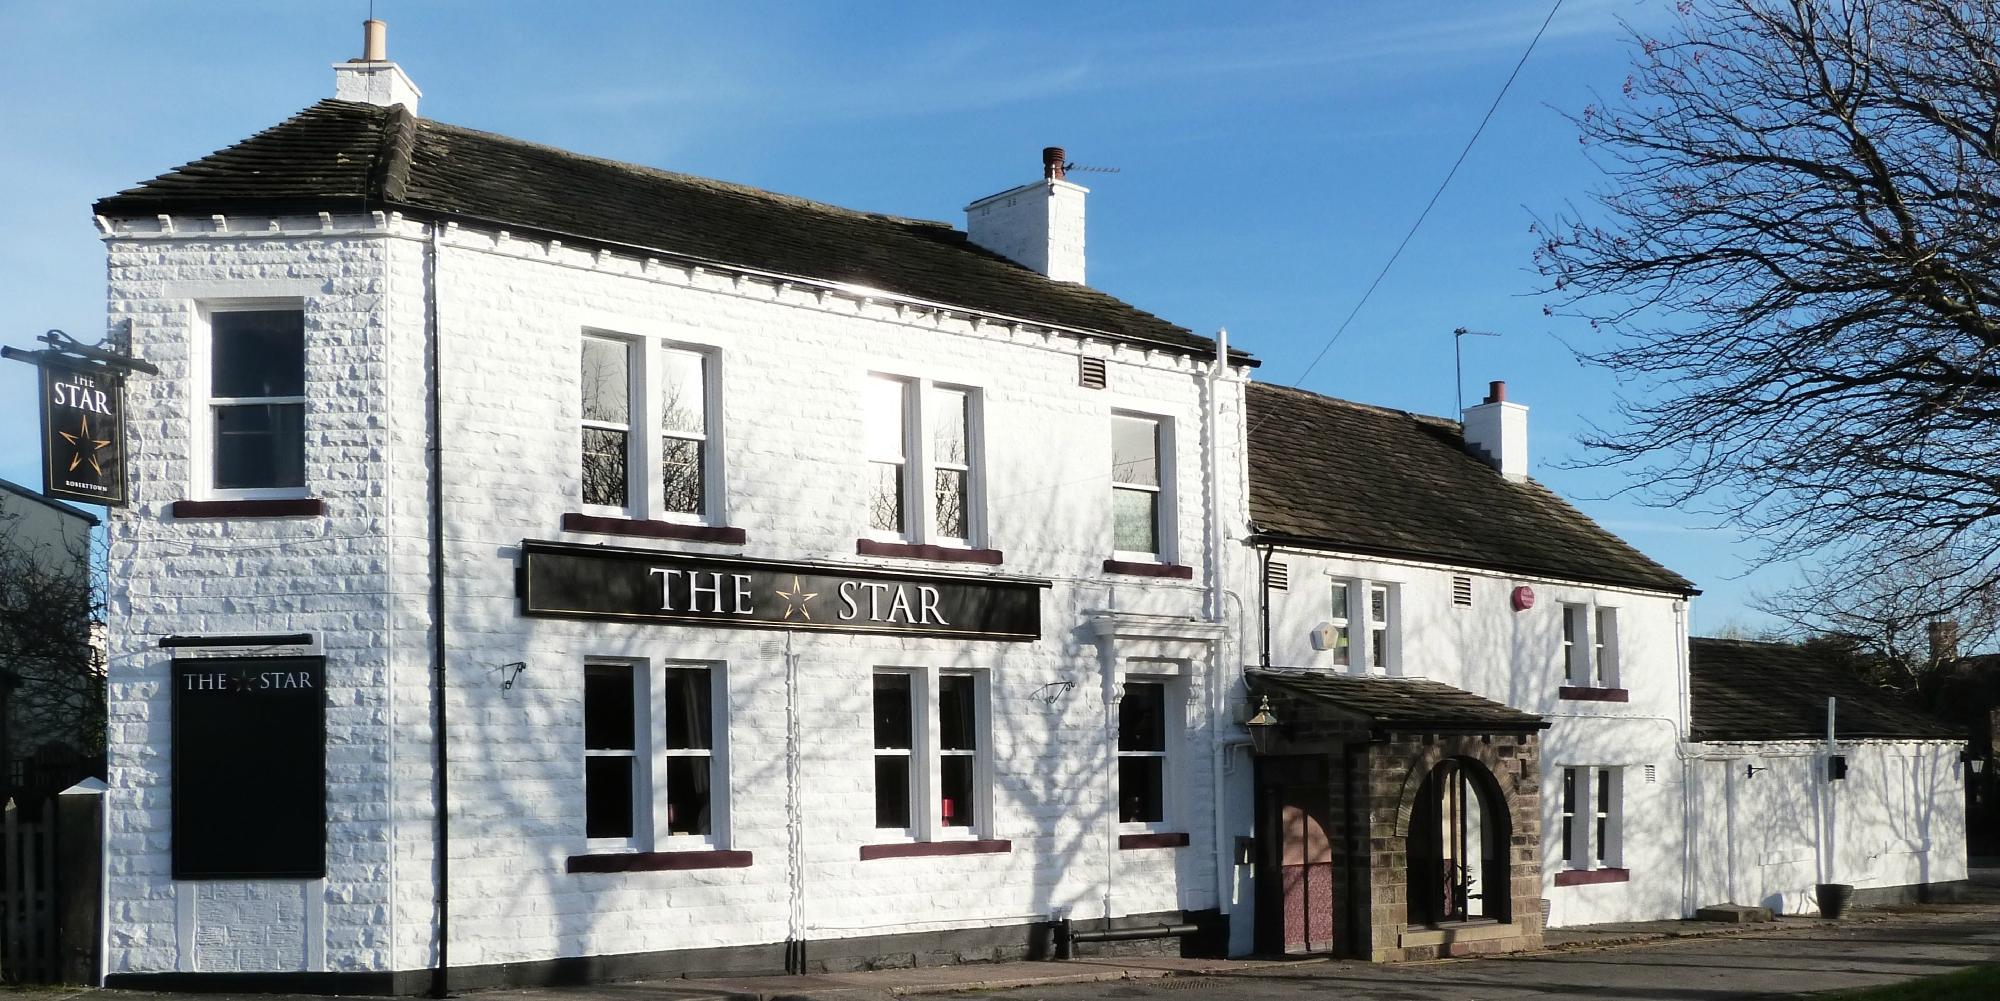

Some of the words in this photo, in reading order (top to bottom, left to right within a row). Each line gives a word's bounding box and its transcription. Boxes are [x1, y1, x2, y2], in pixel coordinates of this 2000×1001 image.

[74, 375, 95, 388] THE
[54, 382, 112, 415] STAR
[65, 480, 108, 492] ROBERTTOWN
[649, 567, 754, 616] THE
[839, 580, 950, 626] STAR
[183, 673, 227, 690] THE
[260, 671, 313, 689] STAR
